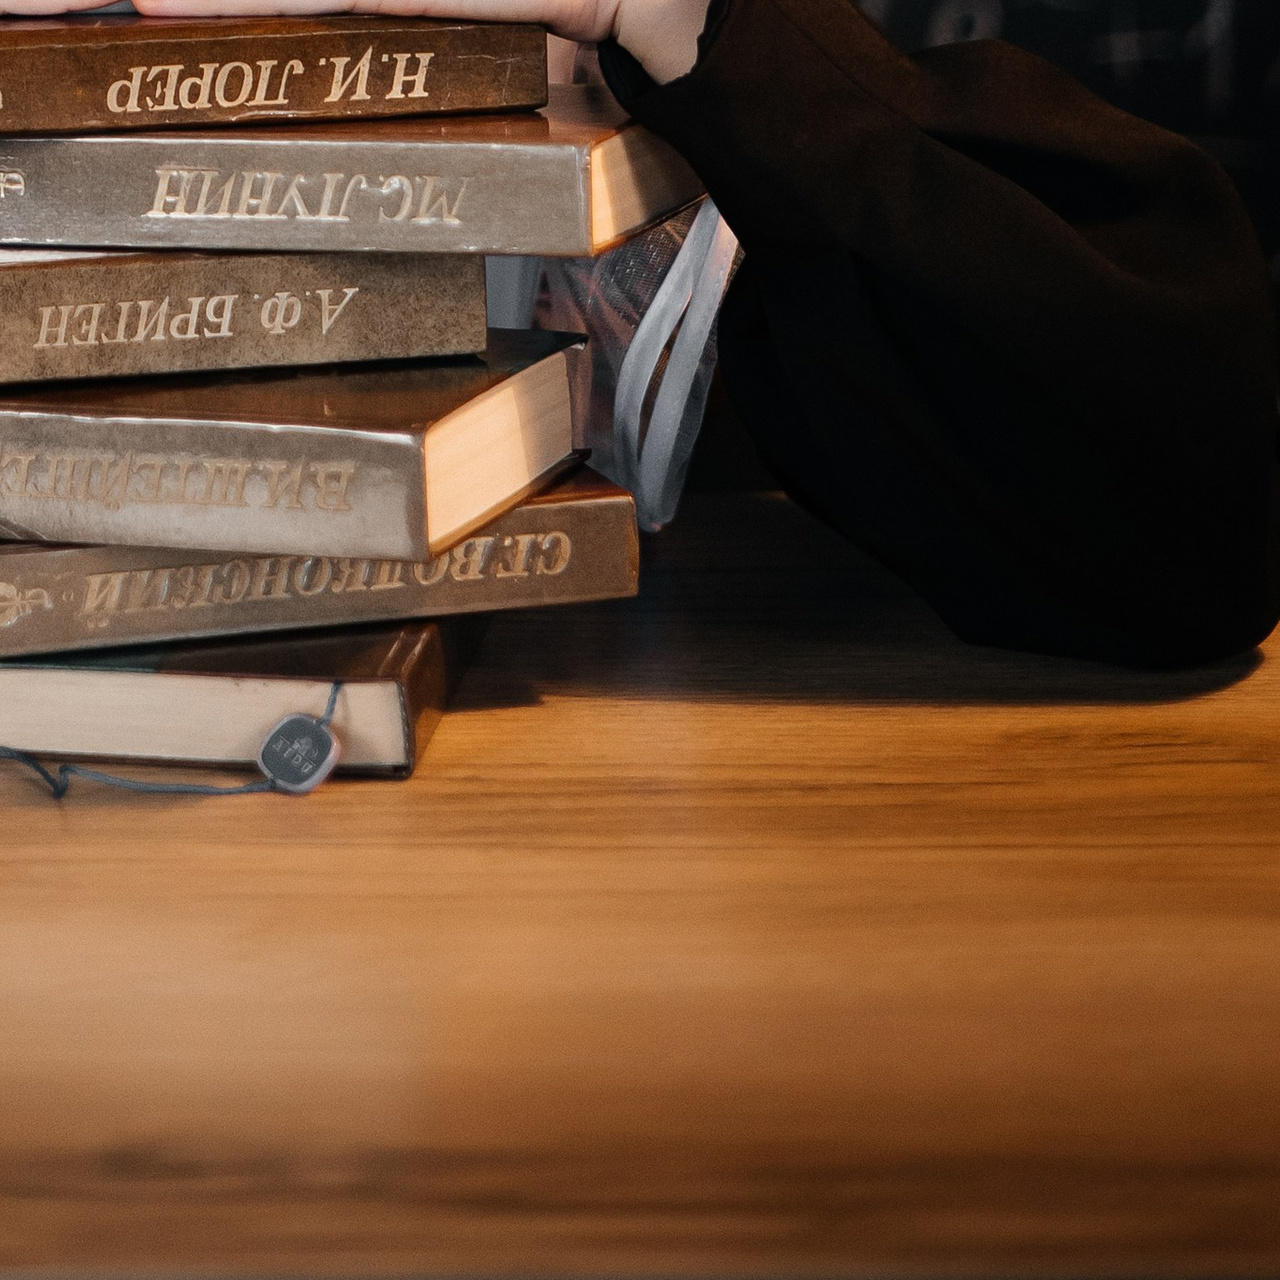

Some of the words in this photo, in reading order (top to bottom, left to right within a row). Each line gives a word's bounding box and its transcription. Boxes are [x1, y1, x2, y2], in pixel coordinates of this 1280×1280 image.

[105, 57, 305, 114] ЛОРЕР
[140, 166, 368, 223] ЛУНИН
[32, 293, 239, 348] БРИГЕН
